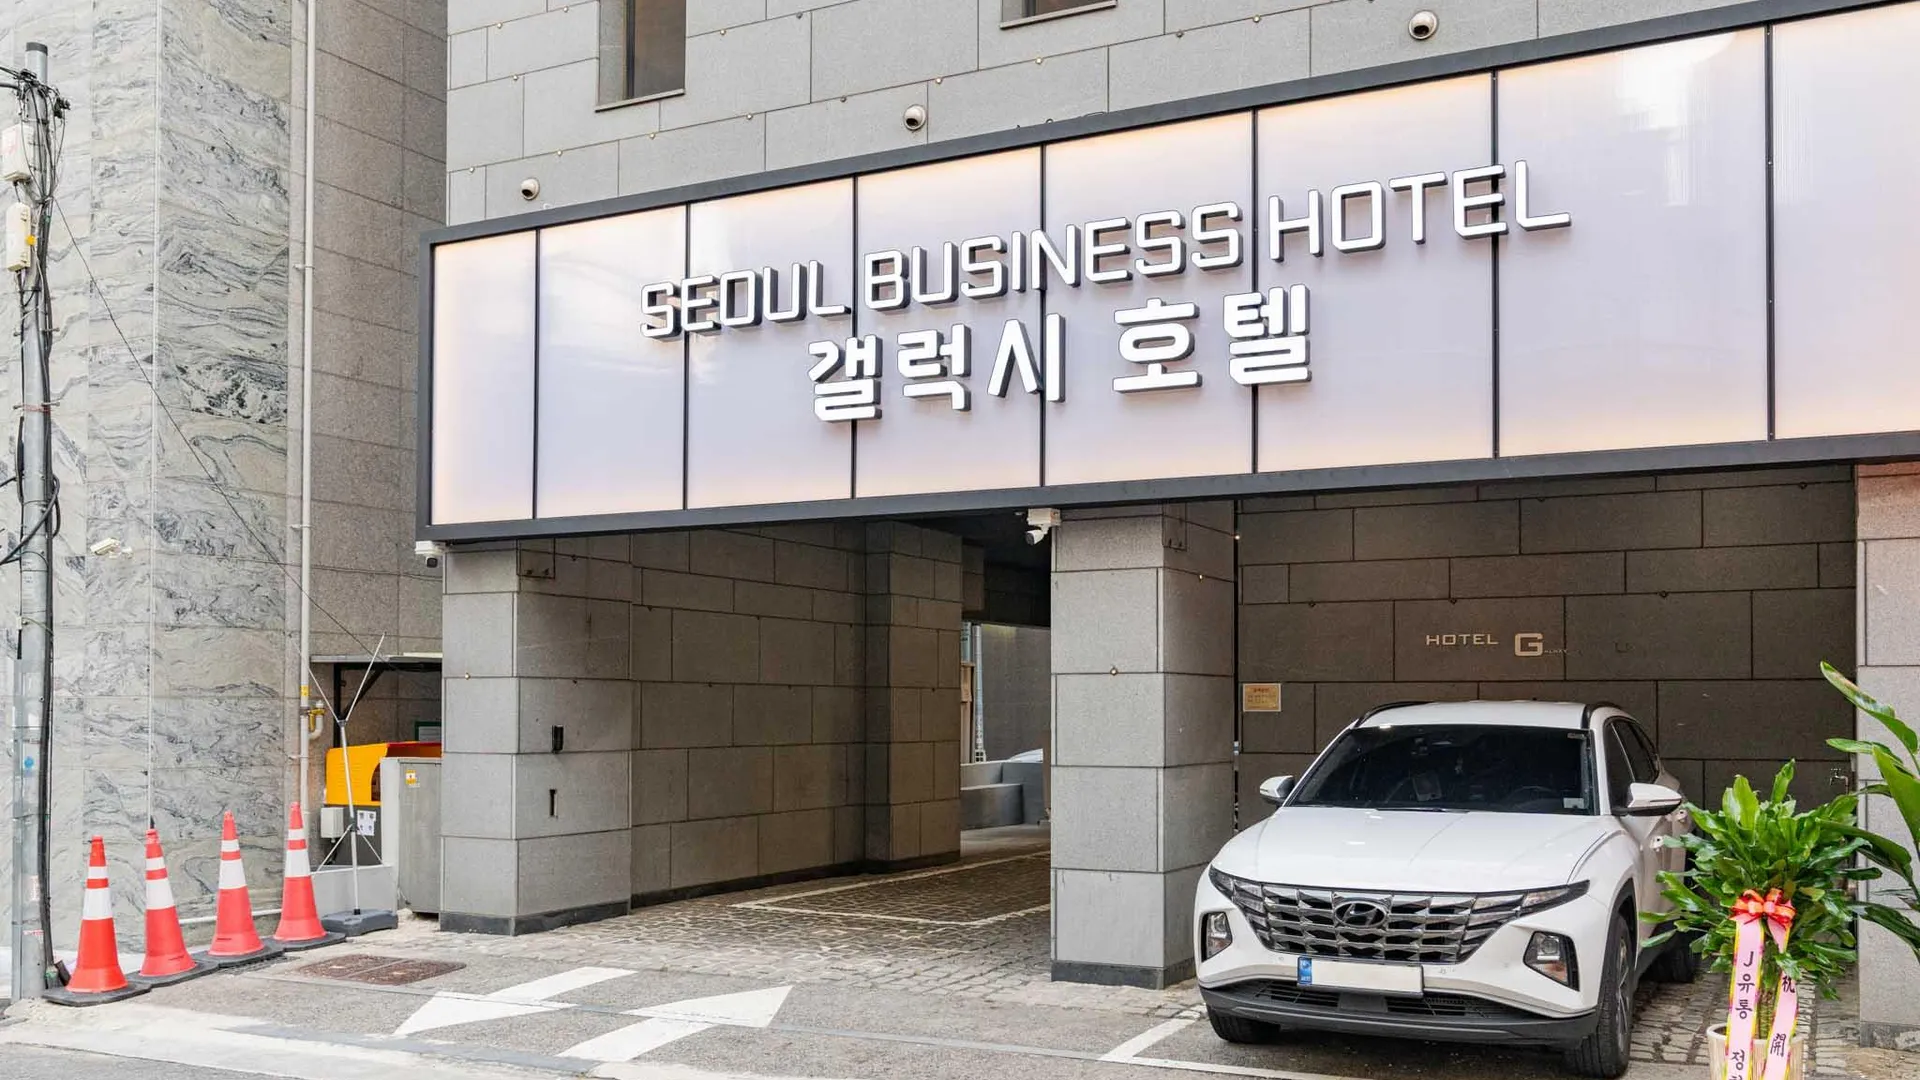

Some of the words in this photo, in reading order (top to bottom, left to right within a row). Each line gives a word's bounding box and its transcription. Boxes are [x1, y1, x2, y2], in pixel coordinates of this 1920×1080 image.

[640, 260, 852, 340] SEOUL
[863, 201, 1244, 311] BUSINESS
[1268, 160, 1572, 262] HOTEL
[807, 313, 1066, 423] 갤럭시
[1112, 283, 1312, 394] 호텔
[1426, 634, 1498, 646] HOTEL
